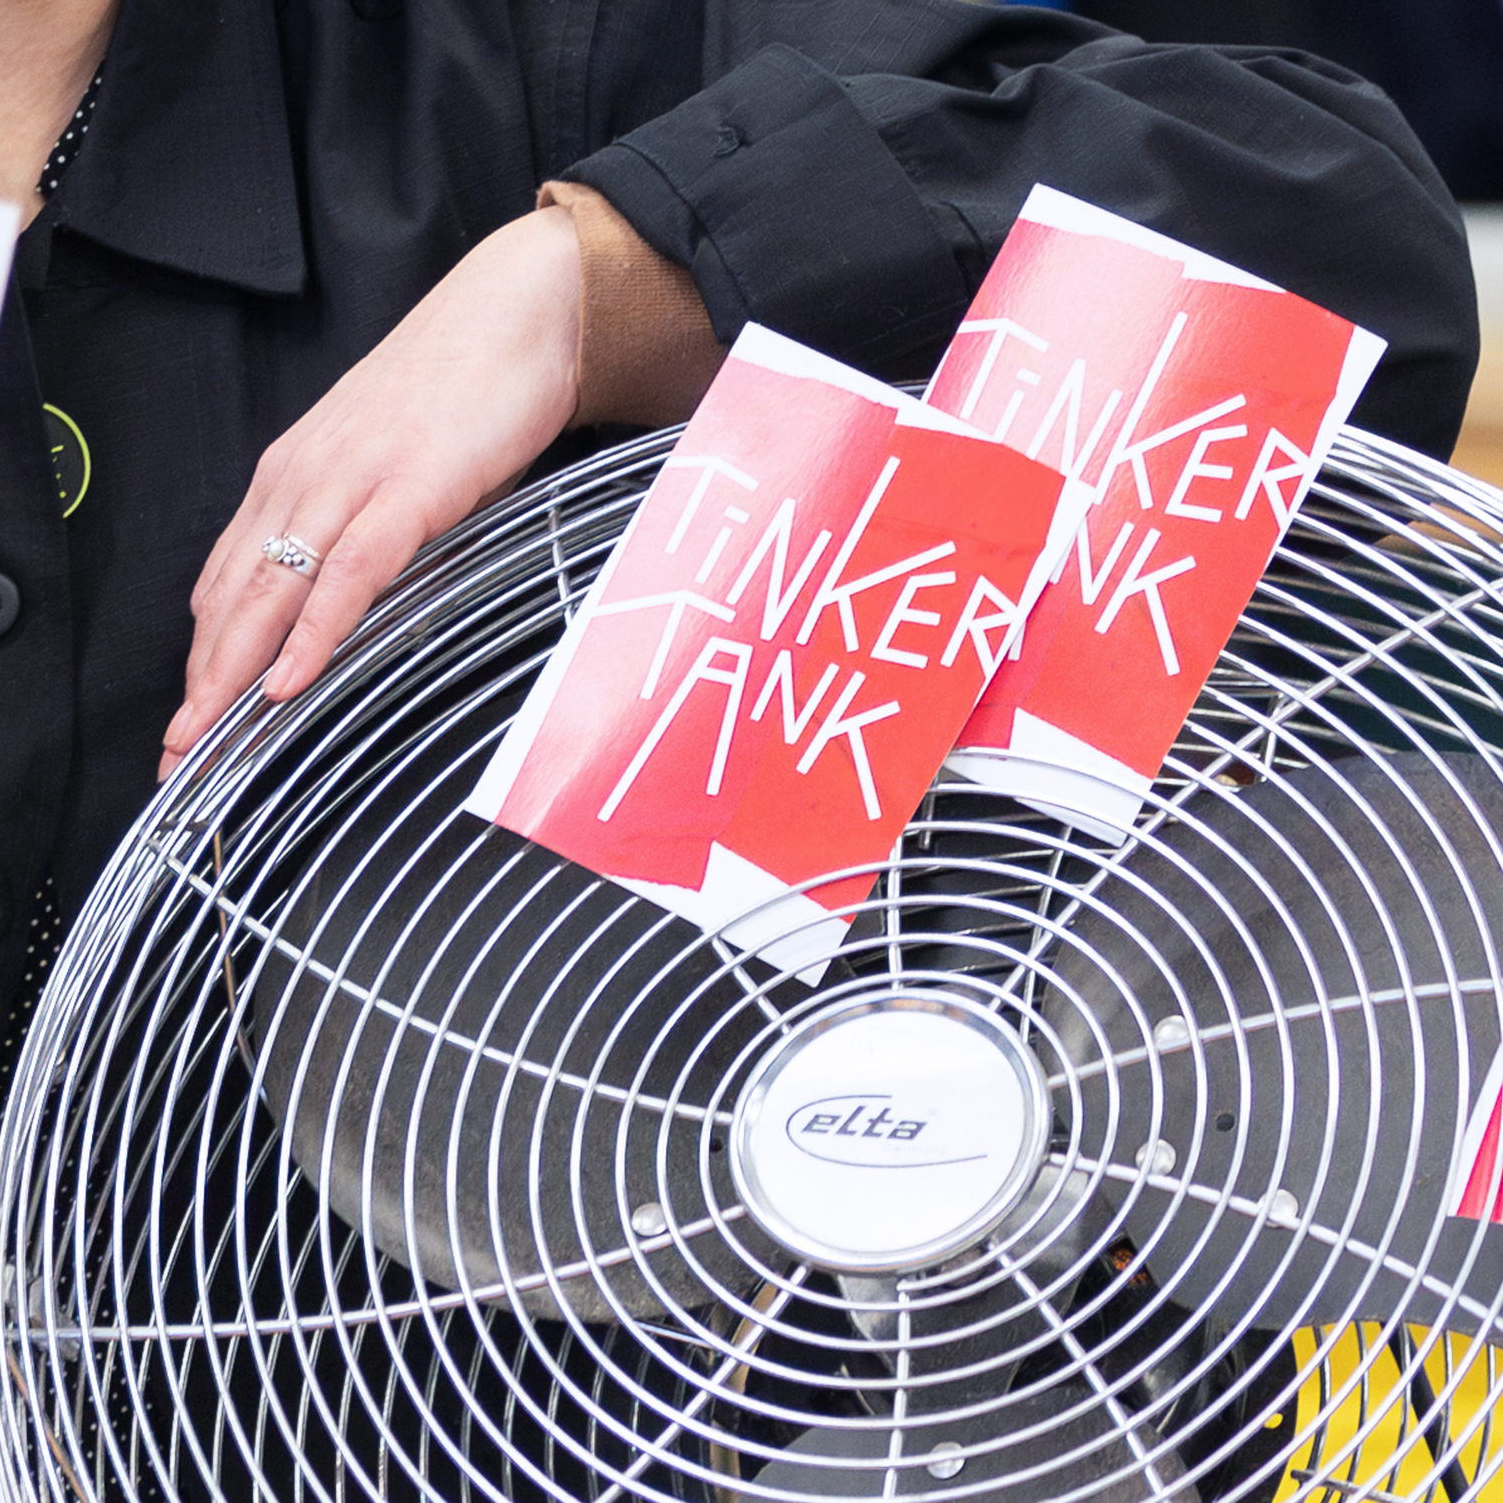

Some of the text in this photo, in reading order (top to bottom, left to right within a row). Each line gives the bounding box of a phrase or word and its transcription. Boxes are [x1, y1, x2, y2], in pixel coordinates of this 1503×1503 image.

[1009, 517, 1196, 676] NK
[593, 590, 900, 821] TANK
[801, 1105, 928, 1140] elta
